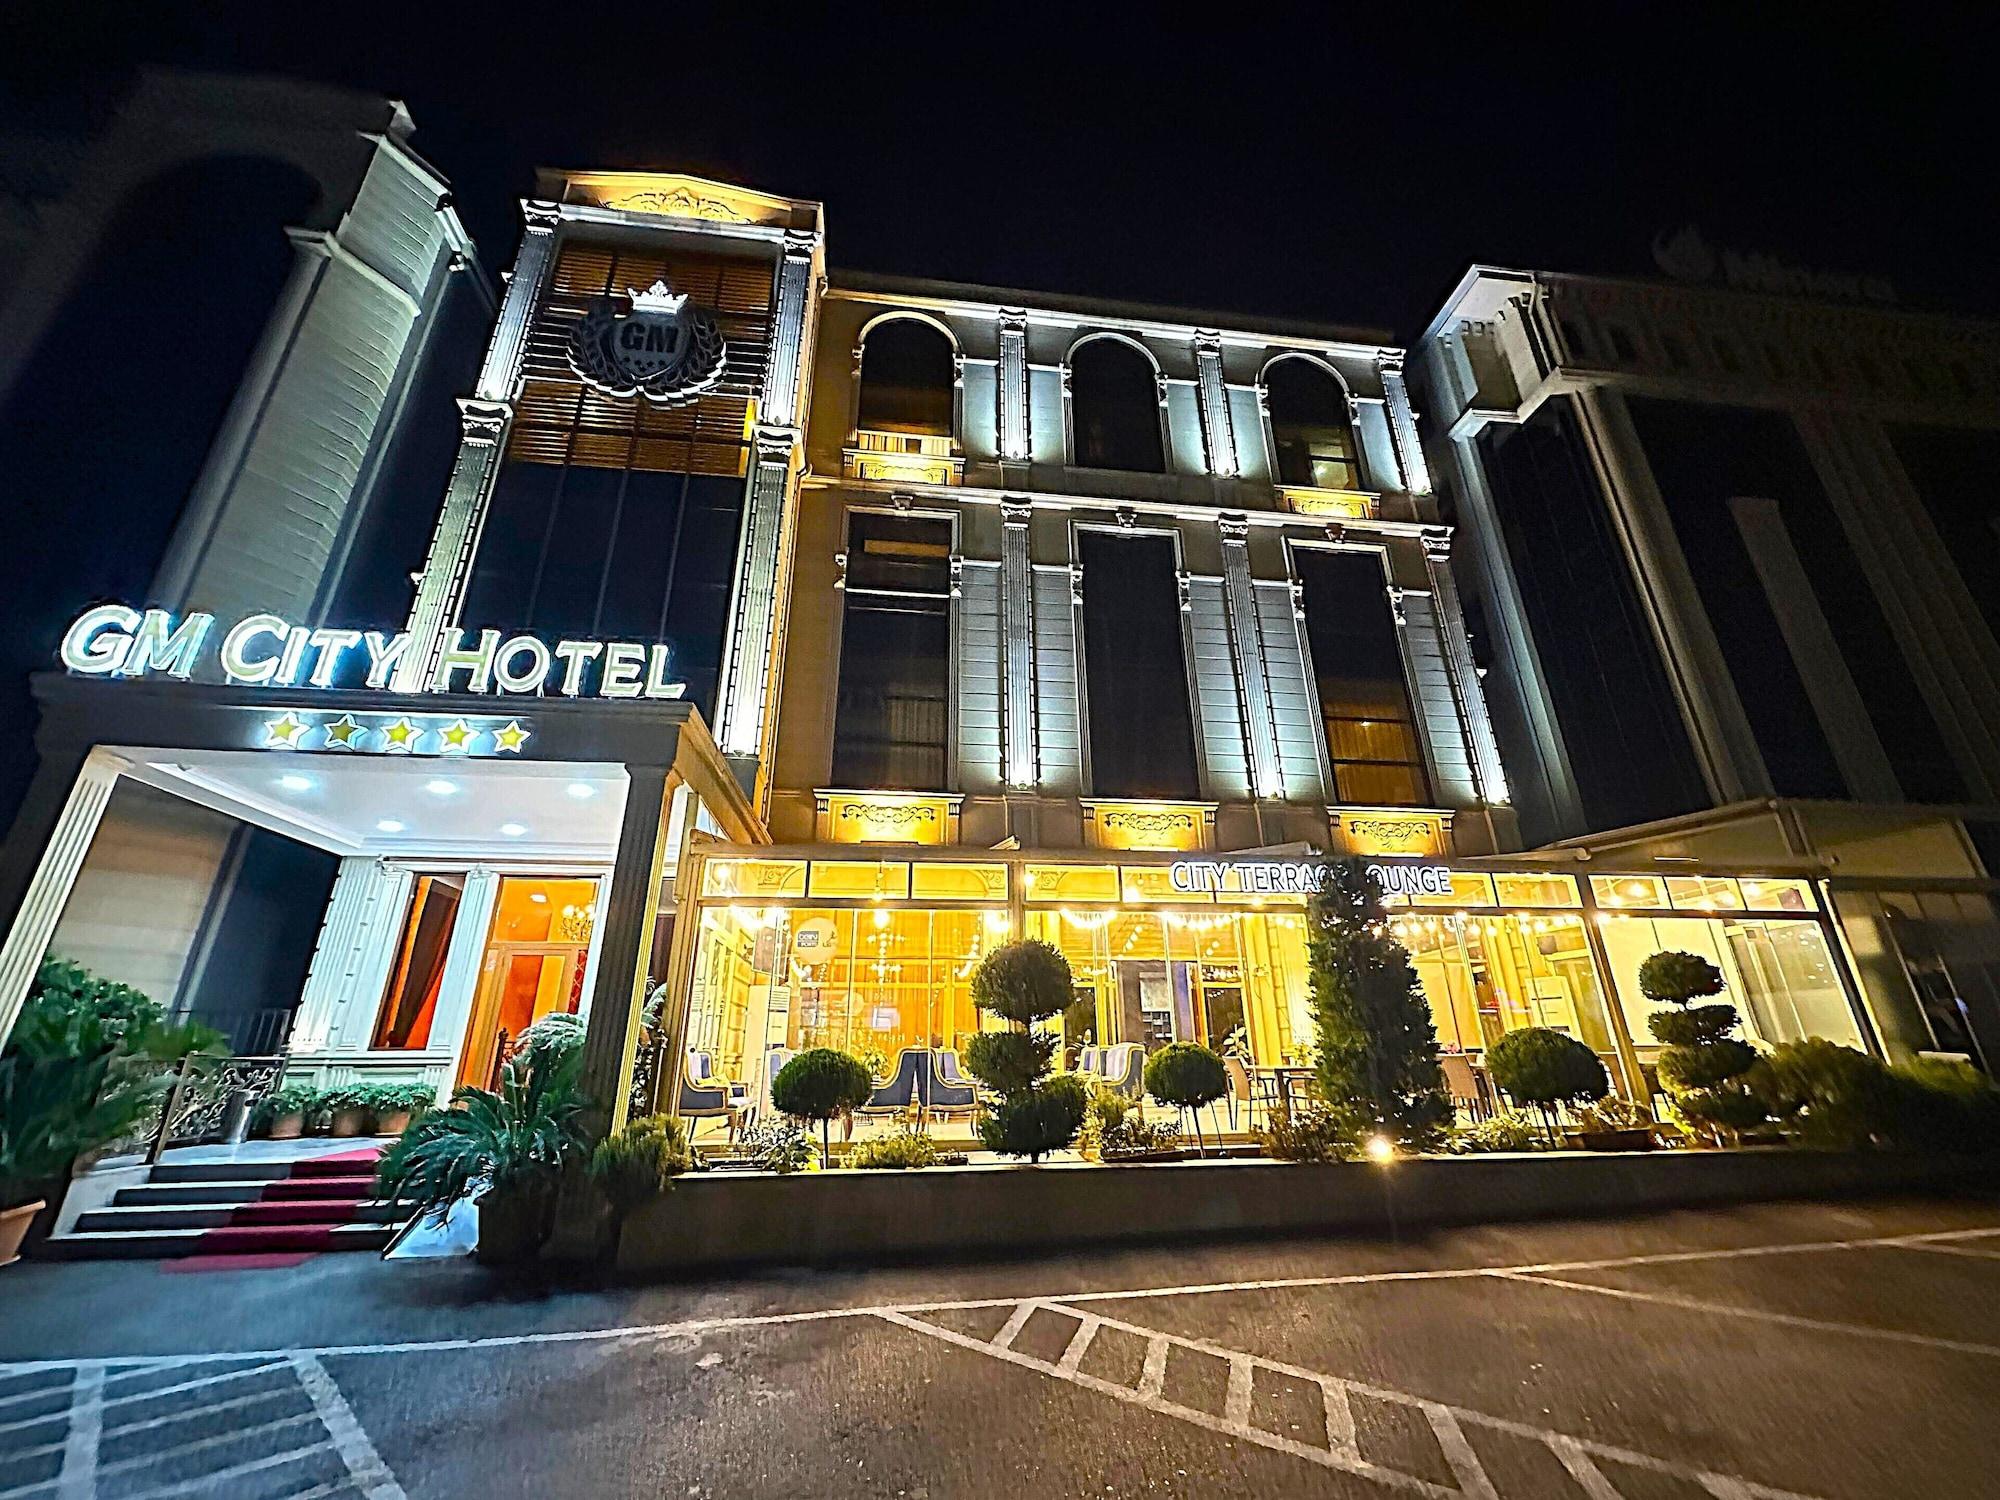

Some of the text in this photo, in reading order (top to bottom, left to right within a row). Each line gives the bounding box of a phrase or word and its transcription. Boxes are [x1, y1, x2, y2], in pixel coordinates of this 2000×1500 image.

[620, 321, 680, 354] GM
[60, 604, 687, 699] GM CITY HOTEL
[1170, 861, 1453, 896] CITY TERRA OUNGE
